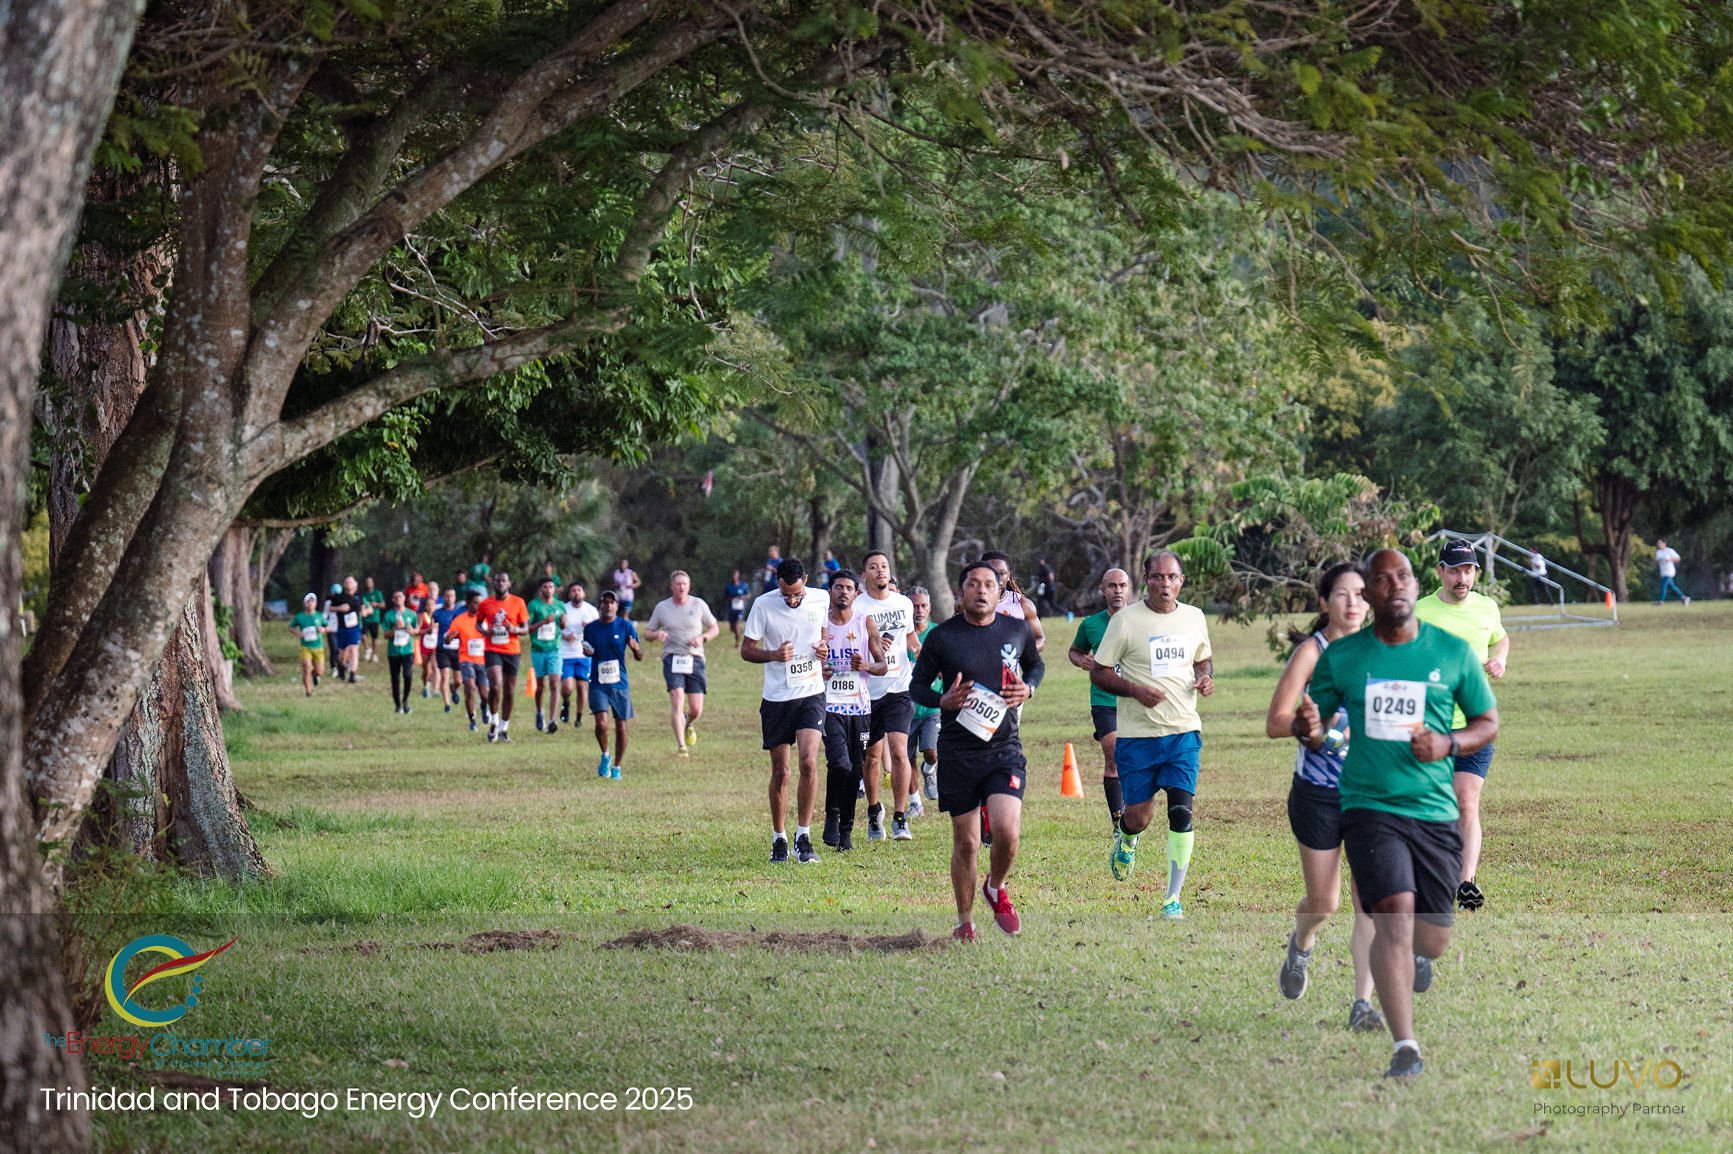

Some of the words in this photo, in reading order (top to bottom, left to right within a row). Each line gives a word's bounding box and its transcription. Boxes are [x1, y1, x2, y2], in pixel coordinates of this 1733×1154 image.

[1155, 647, 1185, 660] 0494
[790, 660, 813, 674] 0358
[831, 680, 855, 690] 0186
[1373, 696, 1416, 716] 0249
